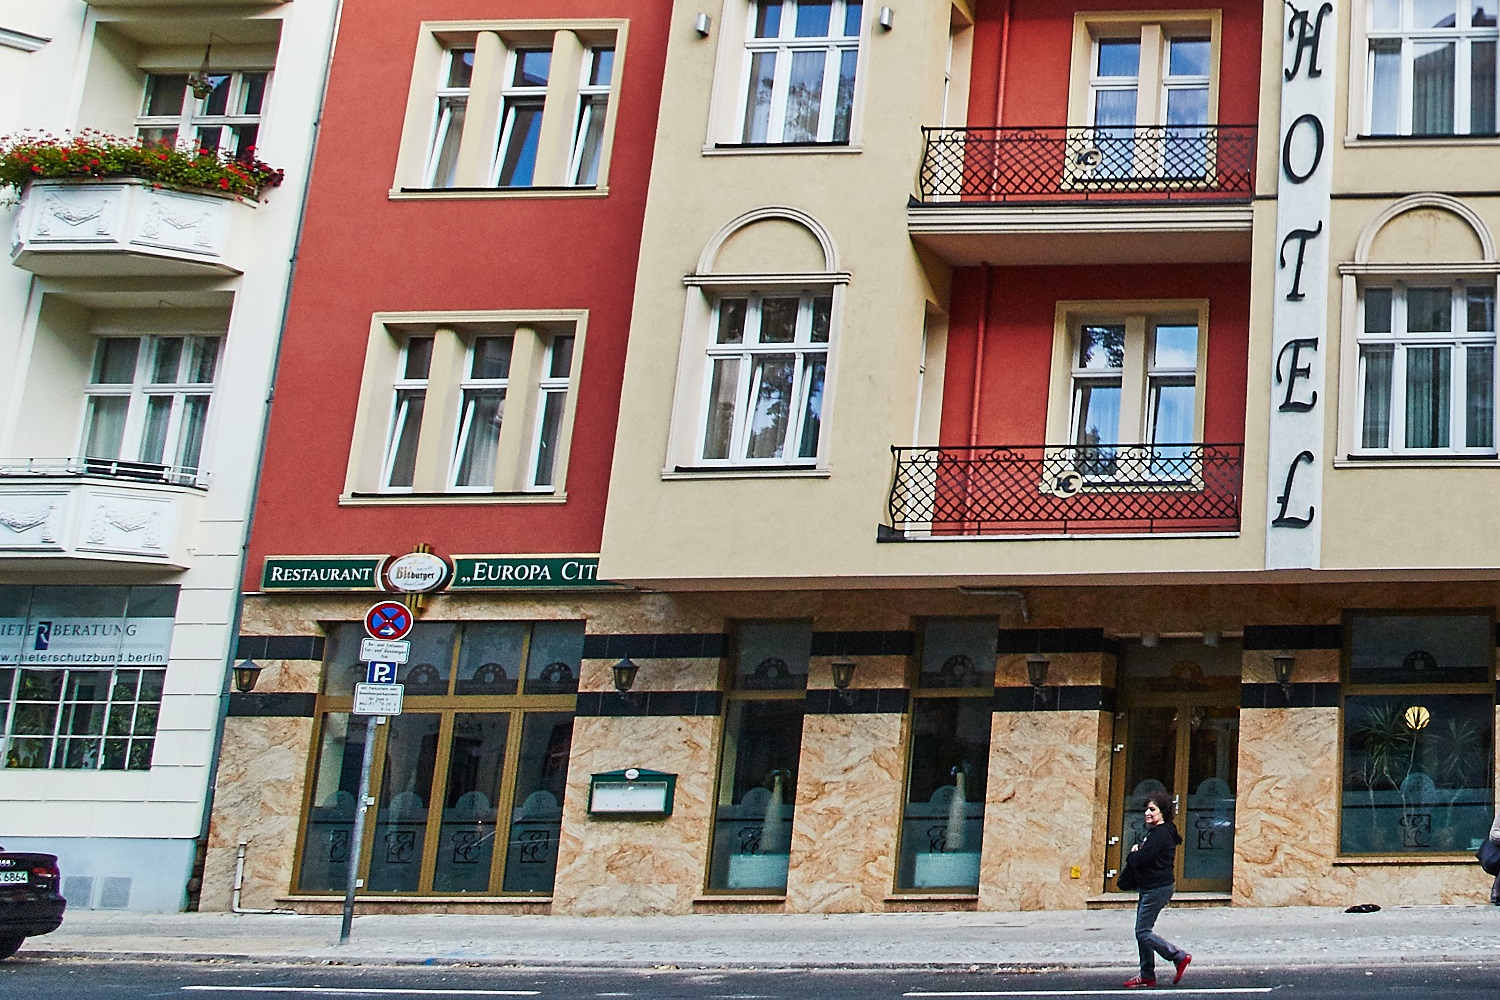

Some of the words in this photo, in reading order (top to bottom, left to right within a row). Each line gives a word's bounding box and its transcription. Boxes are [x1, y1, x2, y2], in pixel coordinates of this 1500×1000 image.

[1272, 2, 1333, 529] HOTEL
[270, 566, 373, 582] RESTAURANT
[561, 561, 597, 580] CIT
[373, 663, 391, 682] P
